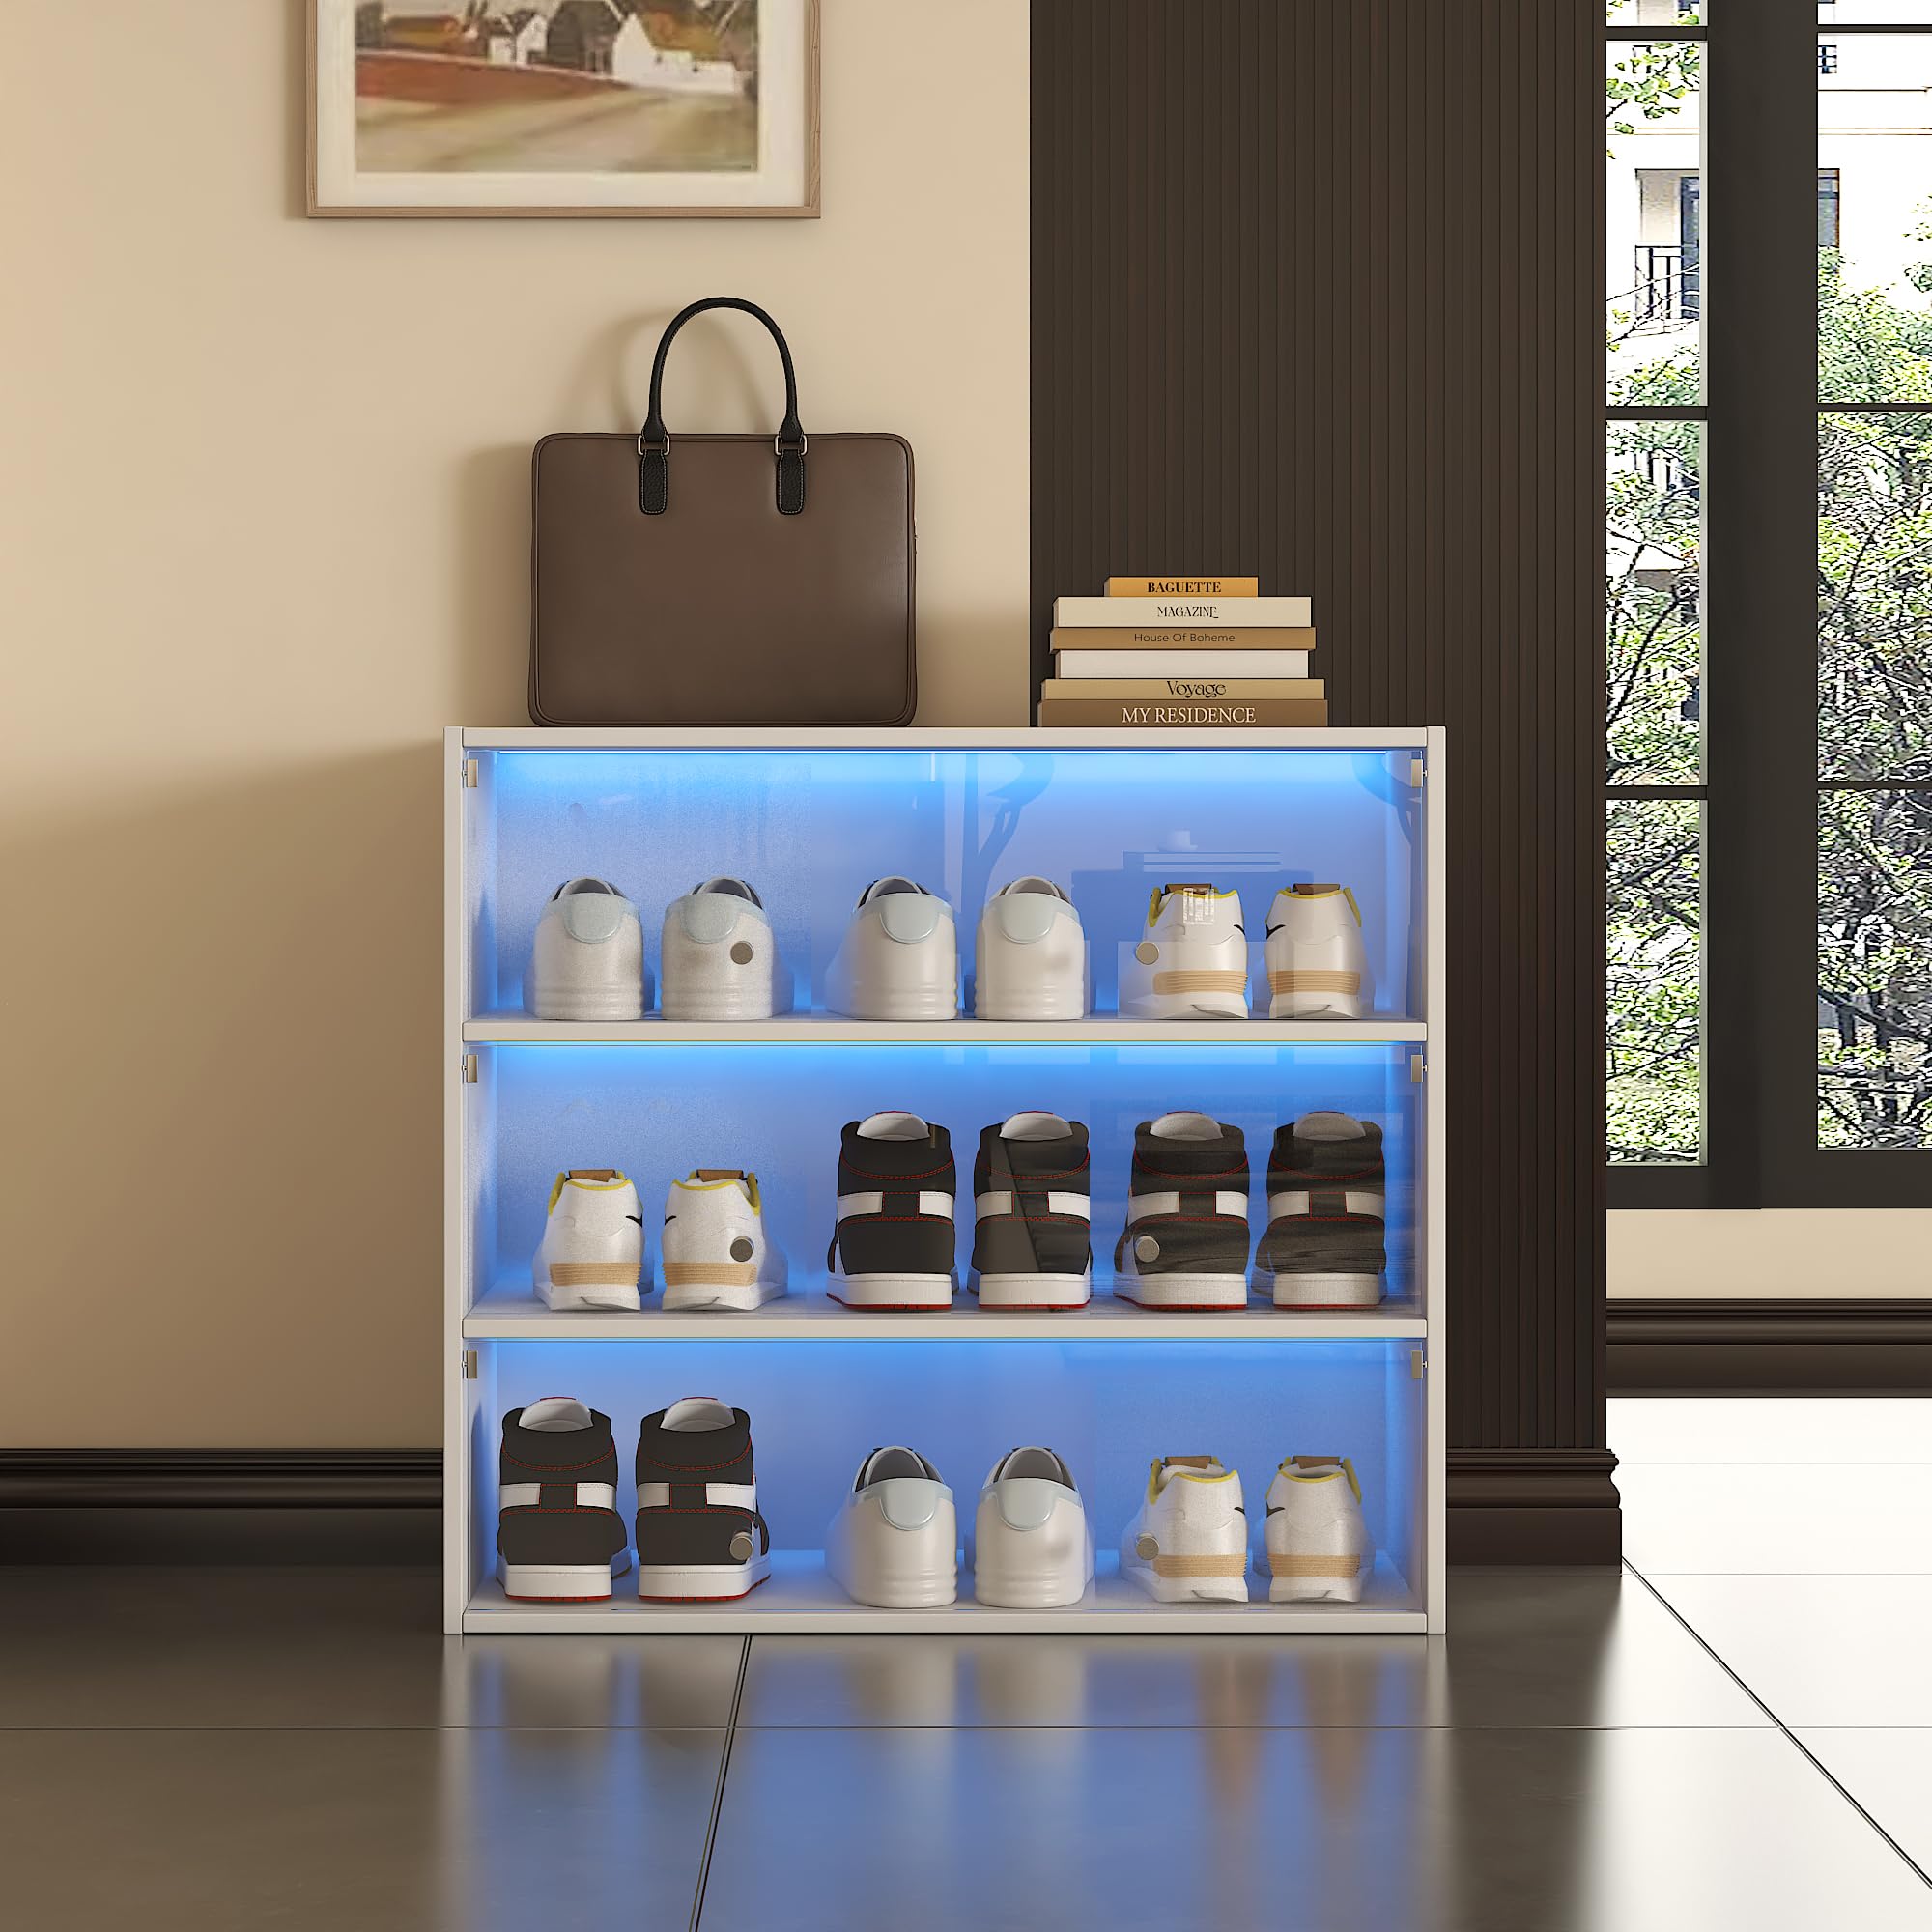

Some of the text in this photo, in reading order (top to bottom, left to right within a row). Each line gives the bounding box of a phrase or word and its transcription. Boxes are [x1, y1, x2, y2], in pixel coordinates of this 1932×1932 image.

[1147, 582, 1222, 594] BAGUETTE
[1157, 606, 1219, 619] MAGAZINE
[1134, 633, 1236, 643] House Of Boheme
[1166, 680, 1227, 698] Voyage
[1122, 707, 1257, 724] MY RESIDENCE
